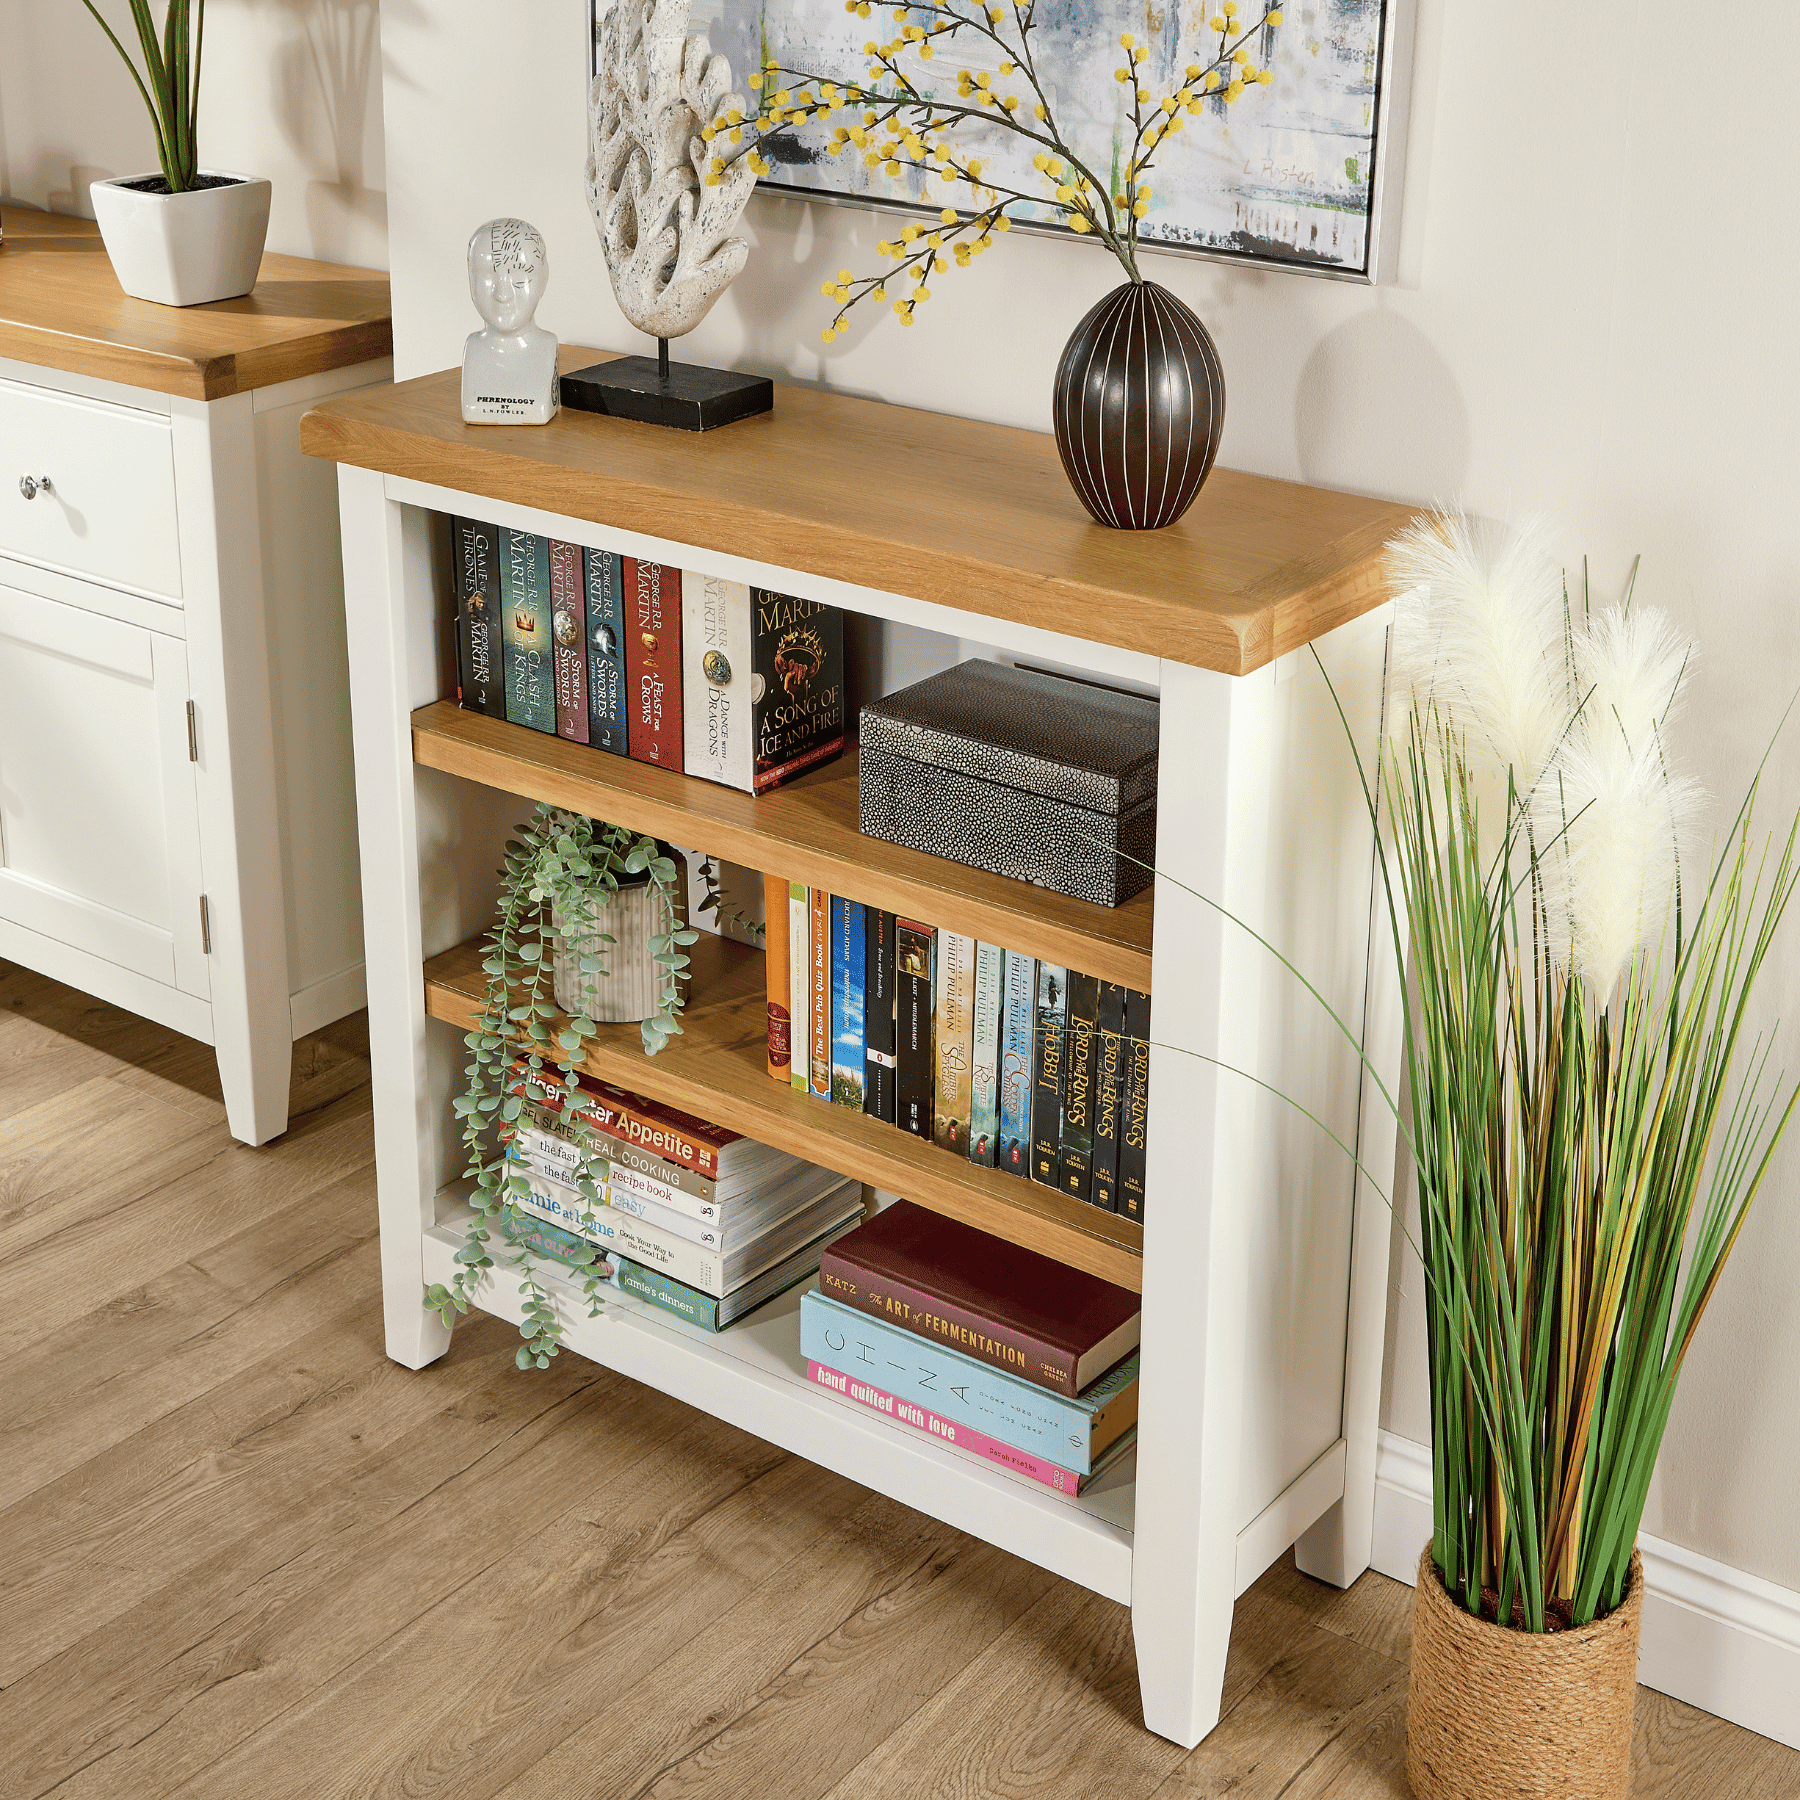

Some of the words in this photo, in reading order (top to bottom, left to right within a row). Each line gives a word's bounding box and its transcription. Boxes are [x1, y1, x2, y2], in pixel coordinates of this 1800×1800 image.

[476, 396, 535, 405] PHRENOLOGY
[462, 526, 476, 593] THRONES
[476, 534, 489, 581] GAME
[510, 528, 526, 612] MARTIN
[526, 533, 536, 587] GEORGE
[552, 540, 566, 610] MARTIN
[565, 544, 575, 590] GEORGE
[603, 552, 613, 597] GEORGE
[590, 548, 603, 618] MARTIN
[638, 559, 652, 629] MARTIN
[651, 563, 661, 608] GEORGE
[718, 580, 727, 627] GEORGE
[704, 574, 718, 647] MARTIN
[471, 619, 486, 683] MARTIN
[481, 623, 490, 665] GEORGE
[513, 630, 524, 651] OF
[527, 633, 538, 644] A
[514, 653, 527, 703] KINGS
[527, 650, 541, 707] CLASH
[560, 647, 571, 708] SWORDS
[571, 659, 582, 699] STORM
[597, 658, 608, 718] SWORDS
[608, 669, 619, 710] STORM
[641, 675, 654, 724] CROWS
[653, 681, 664, 718] FEAST
[708, 687, 720, 757] DRAGONS
[720, 698, 730, 739] DANCE
[760, 733, 782, 758] ICE
[784, 723, 810, 747] AND
[812, 707, 840, 734] FIRE
[761, 716, 770, 736] A
[774, 695, 817, 729] SONG
[821, 684, 839, 707] OF
[948, 935, 956, 974] PHILIP
[979, 949, 988, 988] PHILIP
[1011, 956, 1020, 996] PHILIP
[816, 969, 824, 992] Quiz
[816, 994, 824, 1013] Pub
[946, 976, 956, 1031] PULLMAN
[816, 1014, 824, 1036] Best
[977, 990, 986, 1045] PULLMAN
[1010, 997, 1019, 1053] PULLMAN
[1072, 1014, 1093, 1060] LORD
[816, 1036, 824, 1055] The
[1020, 1056, 1028, 1074] THE
[1039, 1020, 1060, 1096] HOBBIT
[1081, 1062, 1087, 1074] OF
[1101, 1026, 1121, 1073] LORD
[1130, 1034, 1150, 1082] LORD
[941, 1042, 958, 1099] SPYGLASS
[948, 1055, 968, 1104] AMBER
[974, 1062, 988, 1092] KNIFE
[980, 1076, 996, 1107] SUBTLE
[1003, 1052, 1021, 1108] COMPASS
[1010, 1070, 1030, 1115] GOLDEN
[520, 1070, 560, 1102] igel
[616, 1112, 693, 1160] Appetite
[1067, 1072, 1089, 1127] RINGS
[1096, 1085, 1117, 1140] RINGS
[1126, 1092, 1148, 1150] RINGS
[540, 1140, 556, 1156] the
[557, 1146, 576, 1164] fast
[612, 1170, 645, 1190] recipe
[646, 1181, 673, 1202] book
[542, 1116, 578, 1139] SLATE
[586, 1138, 617, 1159] REAL
[621, 1151, 681, 1186] COOKING
[1036, 1144, 1056, 1156] TOLKIEN
[1066, 1158, 1085, 1171] TOLKIEN
[544, 1164, 560, 1180] the
[561, 1171, 580, 1188] fast
[614, 1194, 646, 1218] easy
[1094, 1172, 1114, 1184] TOLKIEN
[1124, 1182, 1143, 1194] TOLKIEN
[512, 1190, 561, 1215] mie
[563, 1208, 574, 1222] at
[620, 1229, 636, 1241] Cook
[636, 1236, 652, 1249] Your
[653, 1243, 667, 1256] Way
[668, 1250, 675, 1258] to
[627, 1241, 638, 1250] the
[638, 1245, 655, 1258] Good
[656, 1253, 669, 1264] Life
[624, 1276, 657, 1297] jamie's
[658, 1292, 694, 1315] dinners
[826, 1273, 857, 1295] KATZ
[869, 1292, 883, 1306] The
[886, 1297, 911, 1319] ART
[912, 1312, 923, 1324] of
[925, 1312, 1026, 1368] FERMENTATION
[825, 1329, 970, 1405] CHINA
[1040, 1362, 1068, 1379] CHELSEA
[1043, 1370, 1064, 1383] GREEN
[817, 1366, 847, 1393] hand
[850, 1382, 894, 1413] quilted
[898, 1402, 925, 1428] with
[928, 1414, 956, 1441] love
